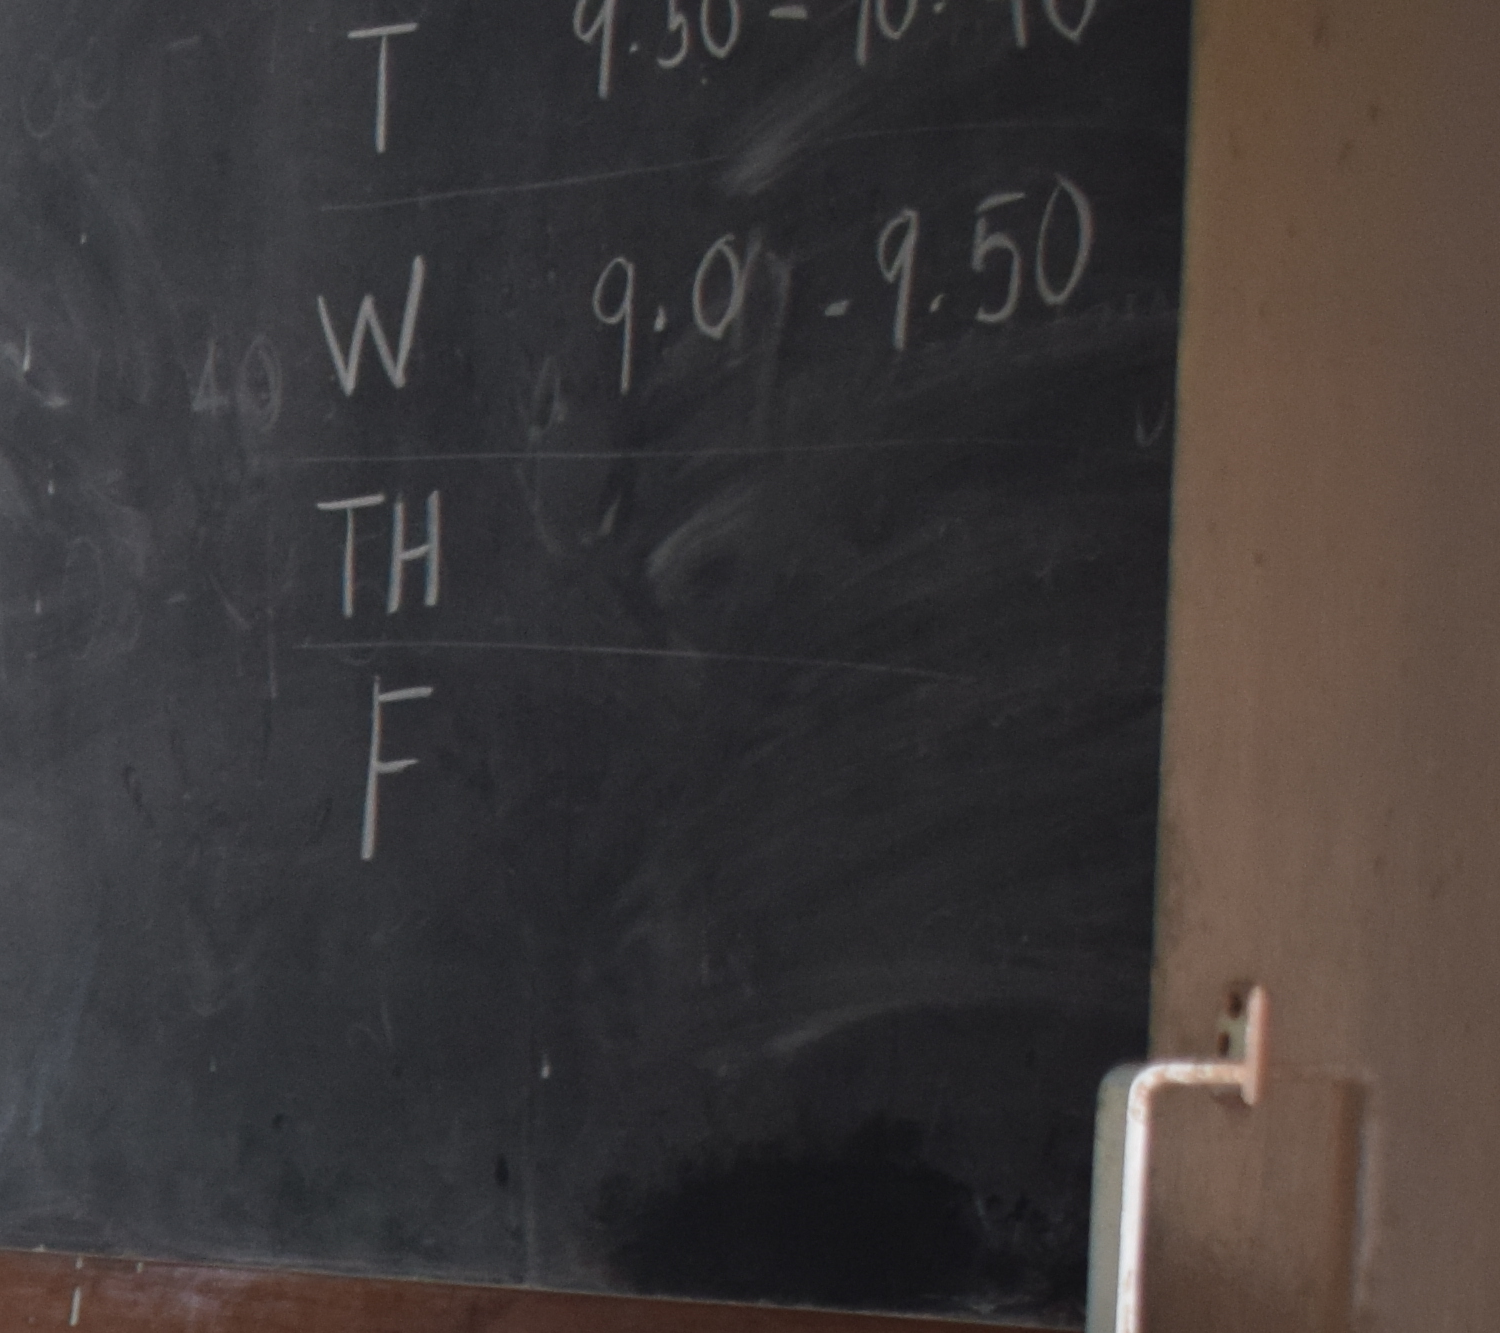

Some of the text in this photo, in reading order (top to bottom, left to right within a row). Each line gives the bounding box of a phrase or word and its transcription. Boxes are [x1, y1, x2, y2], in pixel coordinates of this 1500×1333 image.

[347, 22, 419, 155] T
[317, 255, 425, 397] W
[316, 489, 441, 618] TH
[360, 675, 435, 861] F
